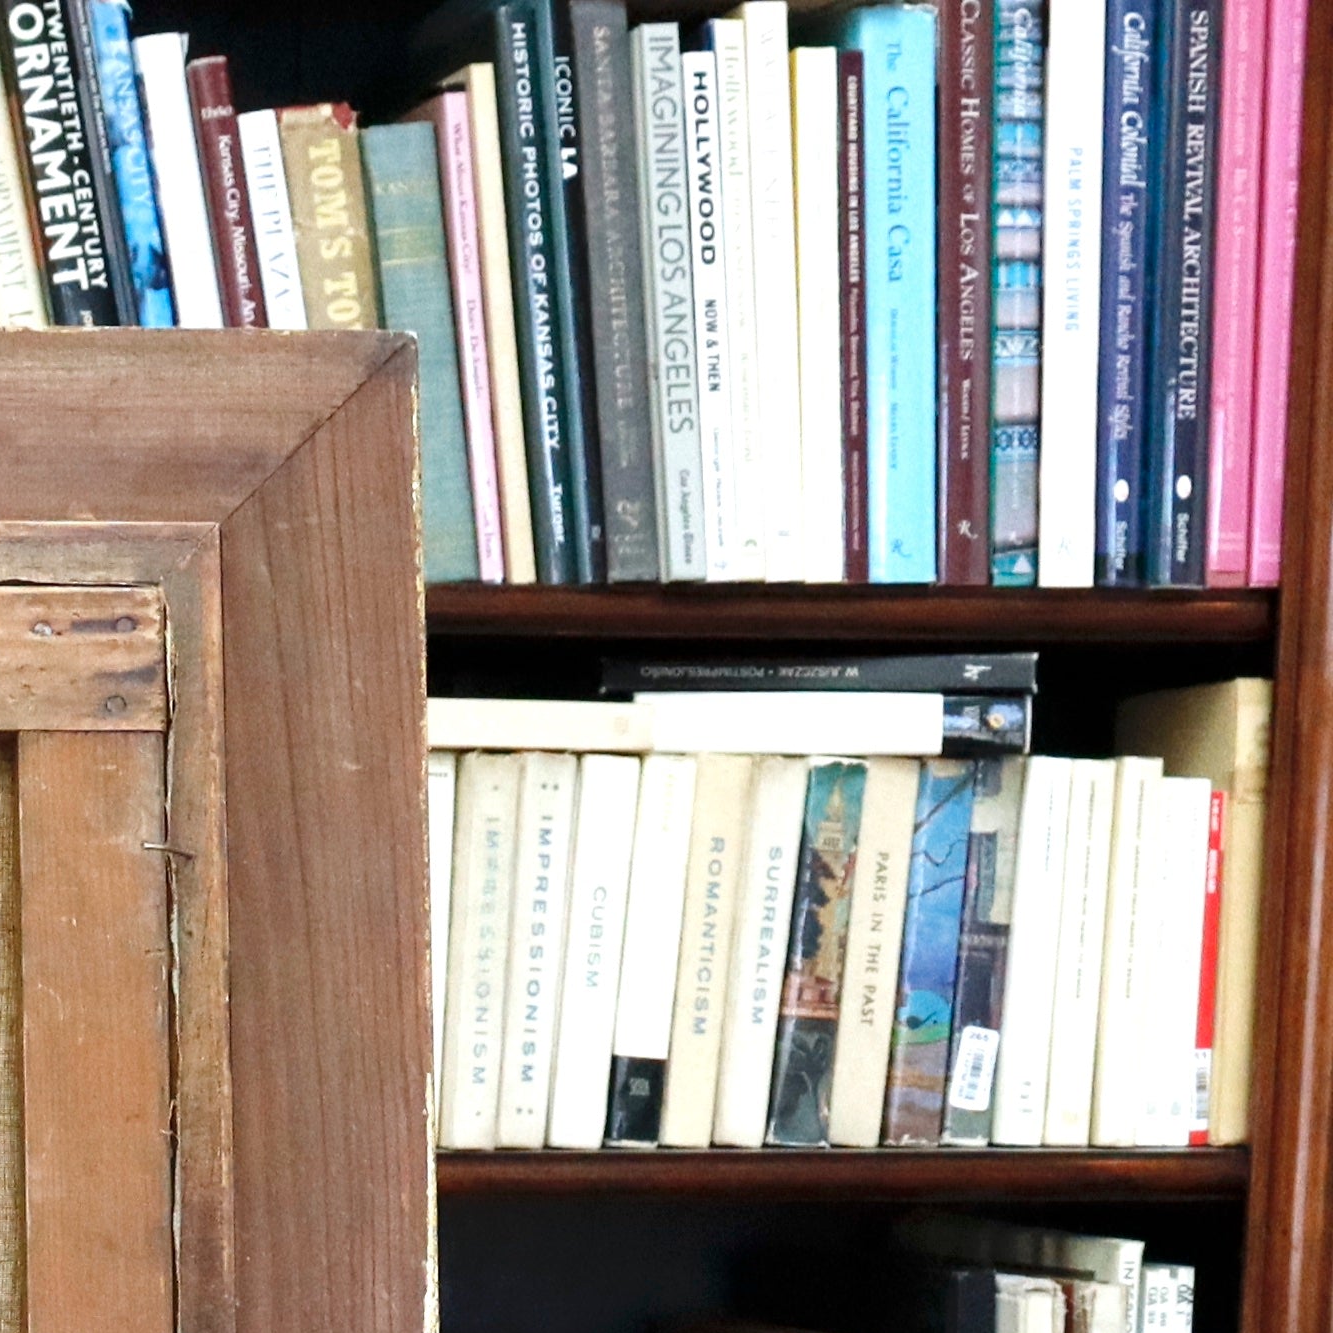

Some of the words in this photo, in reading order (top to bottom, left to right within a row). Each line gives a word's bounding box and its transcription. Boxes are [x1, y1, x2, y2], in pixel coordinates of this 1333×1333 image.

[886, 43, 902, 71] The
[960, 0, 981, 90] CLASSIC
[1112, 12, 1149, 105] California
[1188, 10, 1209, 113] SPANISH
[511, 21, 535, 139] HISTORIC
[554, 56, 576, 139] ICONIC
[846, 75, 859, 141] COURTYARD
[9, 3, 90, 291] ORNAMENT
[218, 134, 235, 188] Kansas
[648, 36, 683, 217] IMAGINING
[886, 86, 911, 215] California
[960, 98, 981, 176] HOMES
[1119, 110, 1148, 188] Colonial
[522, 145, 544, 248] PHOTOS
[560, 148, 579, 180] LA
[693, 71, 716, 265] HOLLYWOOD
[847, 142, 859, 196] HOUSING
[1066, 147, 1083, 190] PALM
[1184, 123, 1206, 222] REVIVAL
[308, 138, 355, 261] TOM'S
[848, 210, 860, 233] LOS
[1065, 198, 1082, 270] SPRINGS
[1120, 193, 1138, 216] The
[658, 224, 687, 283] LOS
[848, 235, 861, 284] ANGELES
[887, 225, 910, 282] Casa
[959, 213, 981, 256] LOS
[1111, 219, 1137, 271] Spanish
[530, 254, 549, 290] OF
[1064, 277, 1081, 331] LIVING
[1117, 275, 1137, 301] and
[534, 293, 556, 389] KANSAS
[705, 299, 718, 333] NOW
[959, 262, 981, 361] ANGELES
[1176, 226, 1203, 420] ARCHITECTURE
[663, 289, 695, 434] ANGELES
[707, 354, 721, 393] THEN
[543, 396, 561, 450] CITY
[778, 665, 842, 678] JUSZCZAK
[873, 851, 890, 902] PARIS
[472, 816, 501, 1085] IMPRESSIONISM
[520, 814, 554, 1083] IMPRESSIONISM
[586, 886, 608, 989] CUBISM
[693, 835, 726, 1036] ROMANTICISM
[751, 845, 785, 1026] SURREALISM
[870, 912, 885, 933] IN
[865, 943, 881, 975] THE
[860, 985, 879, 1027] PAST
